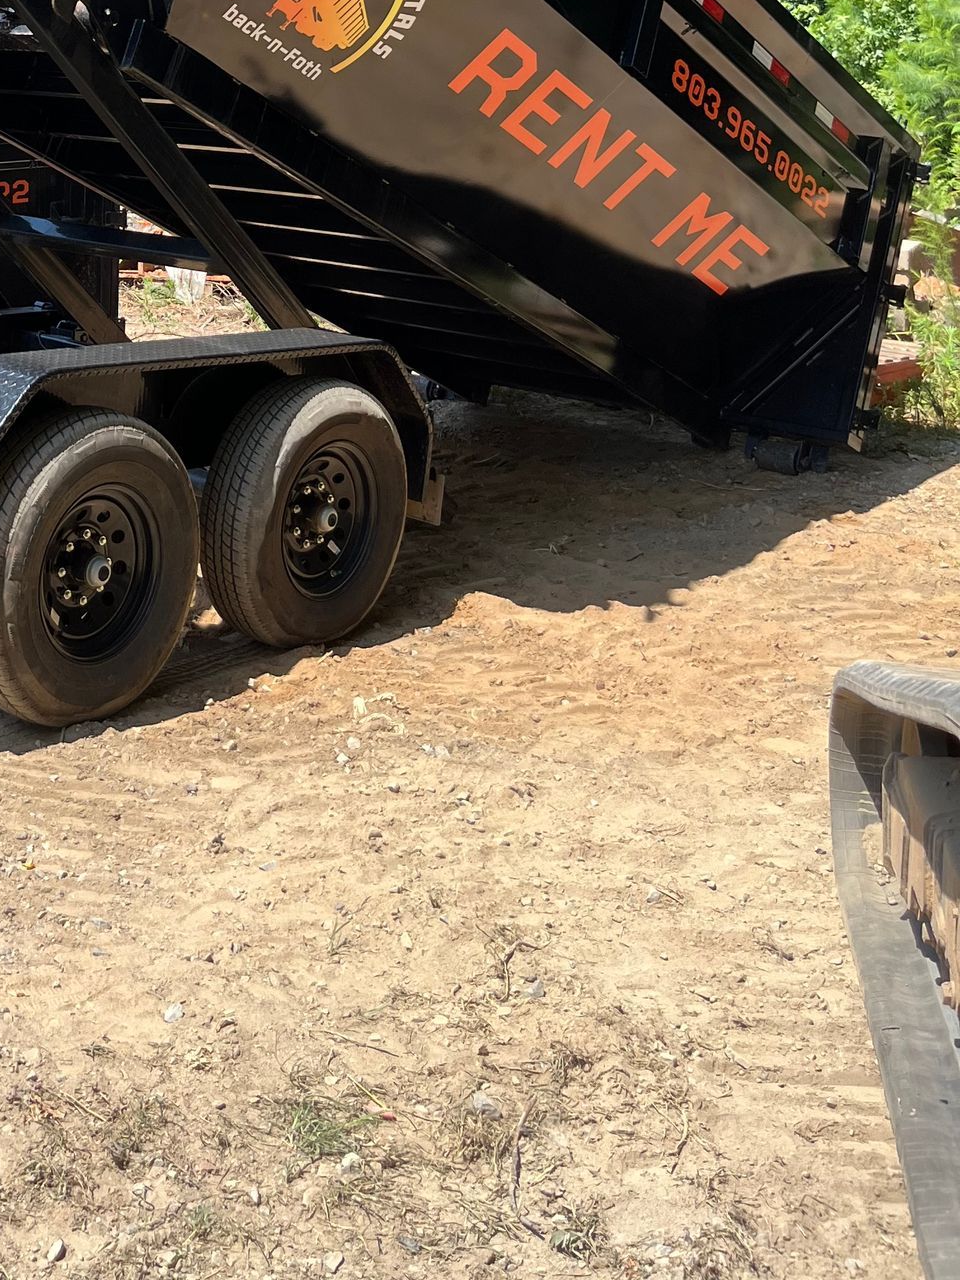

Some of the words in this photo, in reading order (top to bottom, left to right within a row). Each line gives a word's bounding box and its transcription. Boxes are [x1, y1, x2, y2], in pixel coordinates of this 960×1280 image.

[222, 3, 323, 81] back-n-Foth
[447, 27, 678, 211] RENT
[650, 191, 771, 297] ME
[671, 58, 831, 219] 803.965.0022
